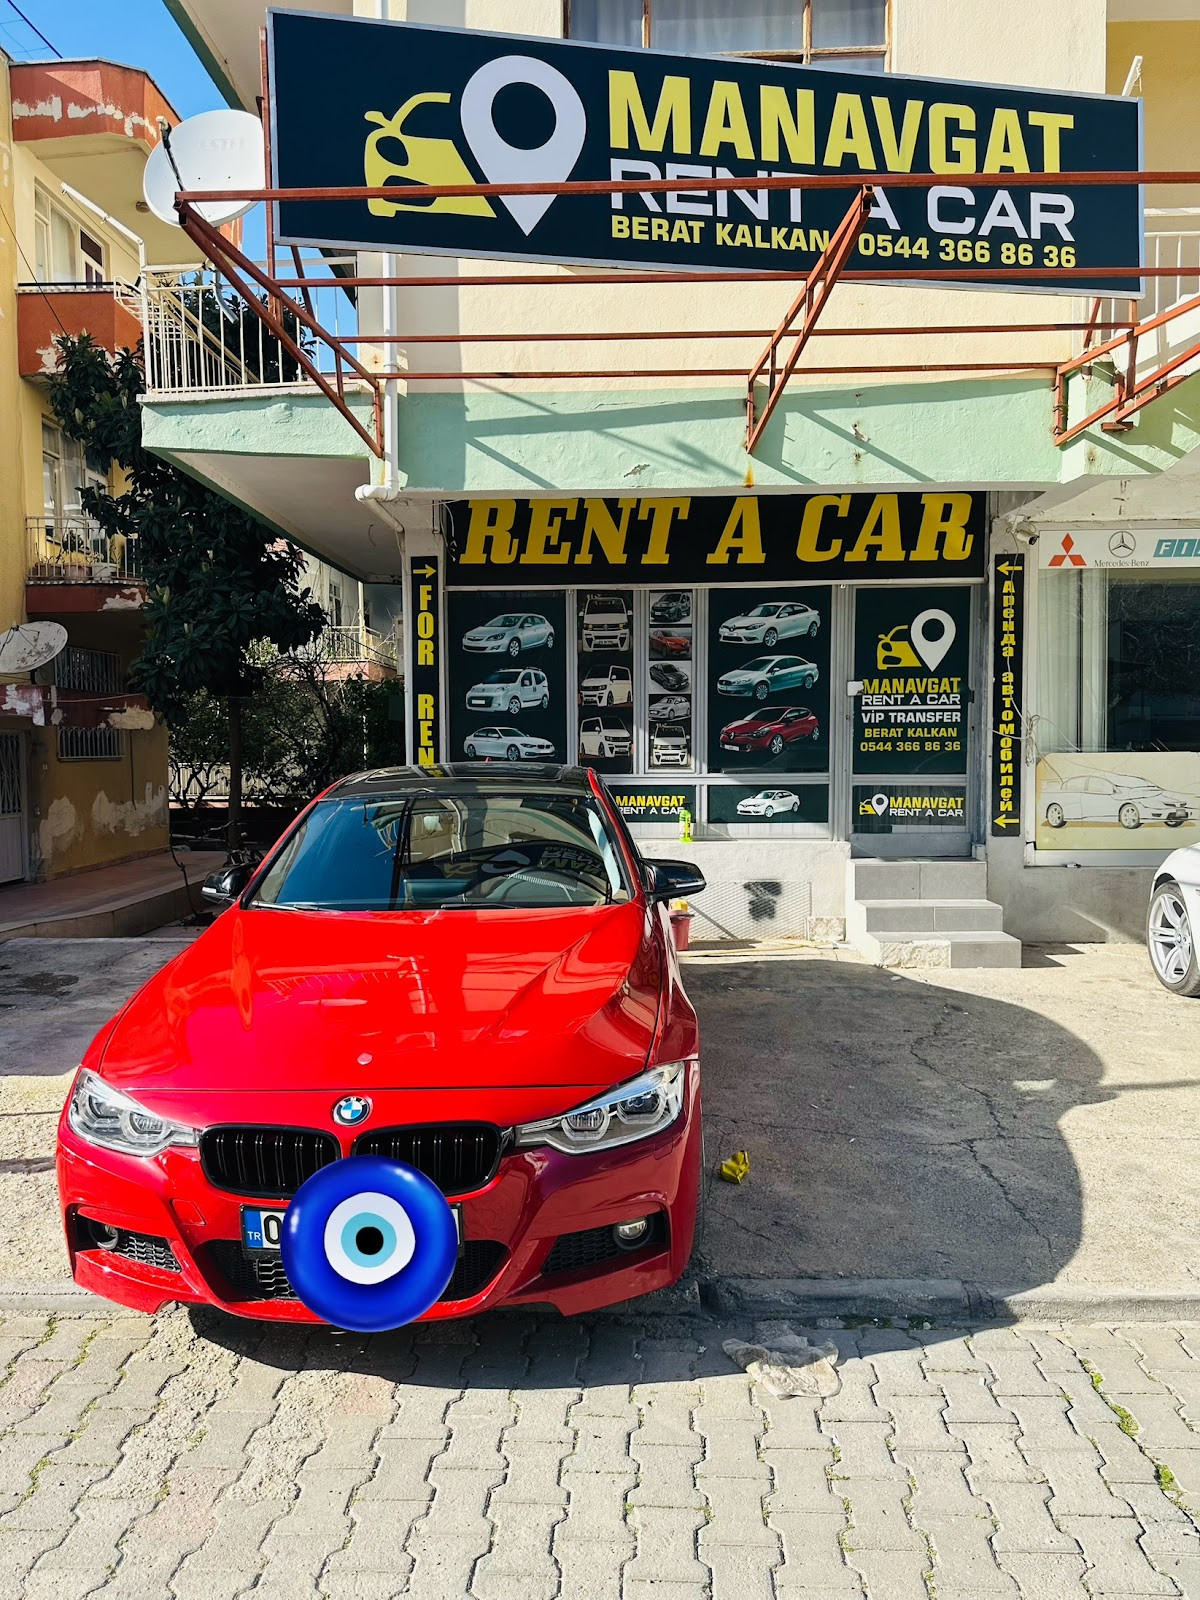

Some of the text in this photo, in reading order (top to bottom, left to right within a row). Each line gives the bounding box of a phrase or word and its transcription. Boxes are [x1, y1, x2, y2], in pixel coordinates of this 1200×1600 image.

[608, 69, 1074, 175] MANAVGAT
[610, 158, 820, 223] RENT
[926, 185, 1075, 242] CAR
[611, 214, 1076, 268] BERAT KALKAN 0544 366 86 36
[459, 492, 974, 565] RENT A CAR
[1158, 541, 1200, 556] FI
[417, 584, 435, 766] FOR REN
[862, 677, 962, 694] MANAVGAT
[862, 694, 961, 706] RENT A CAR
[888, 712, 961, 723] TRANSFER
[864, 727, 958, 738] BERAT KALKAN
[860, 741, 961, 752] 0544 366 86 36
[615, 795, 686, 807] MANAVGAT
[889, 796, 964, 809] MANAVGAT
[649, 806, 659, 815] A
[889, 808, 964, 818] RENT A CAR
[247, 1231, 262, 1241] TR
